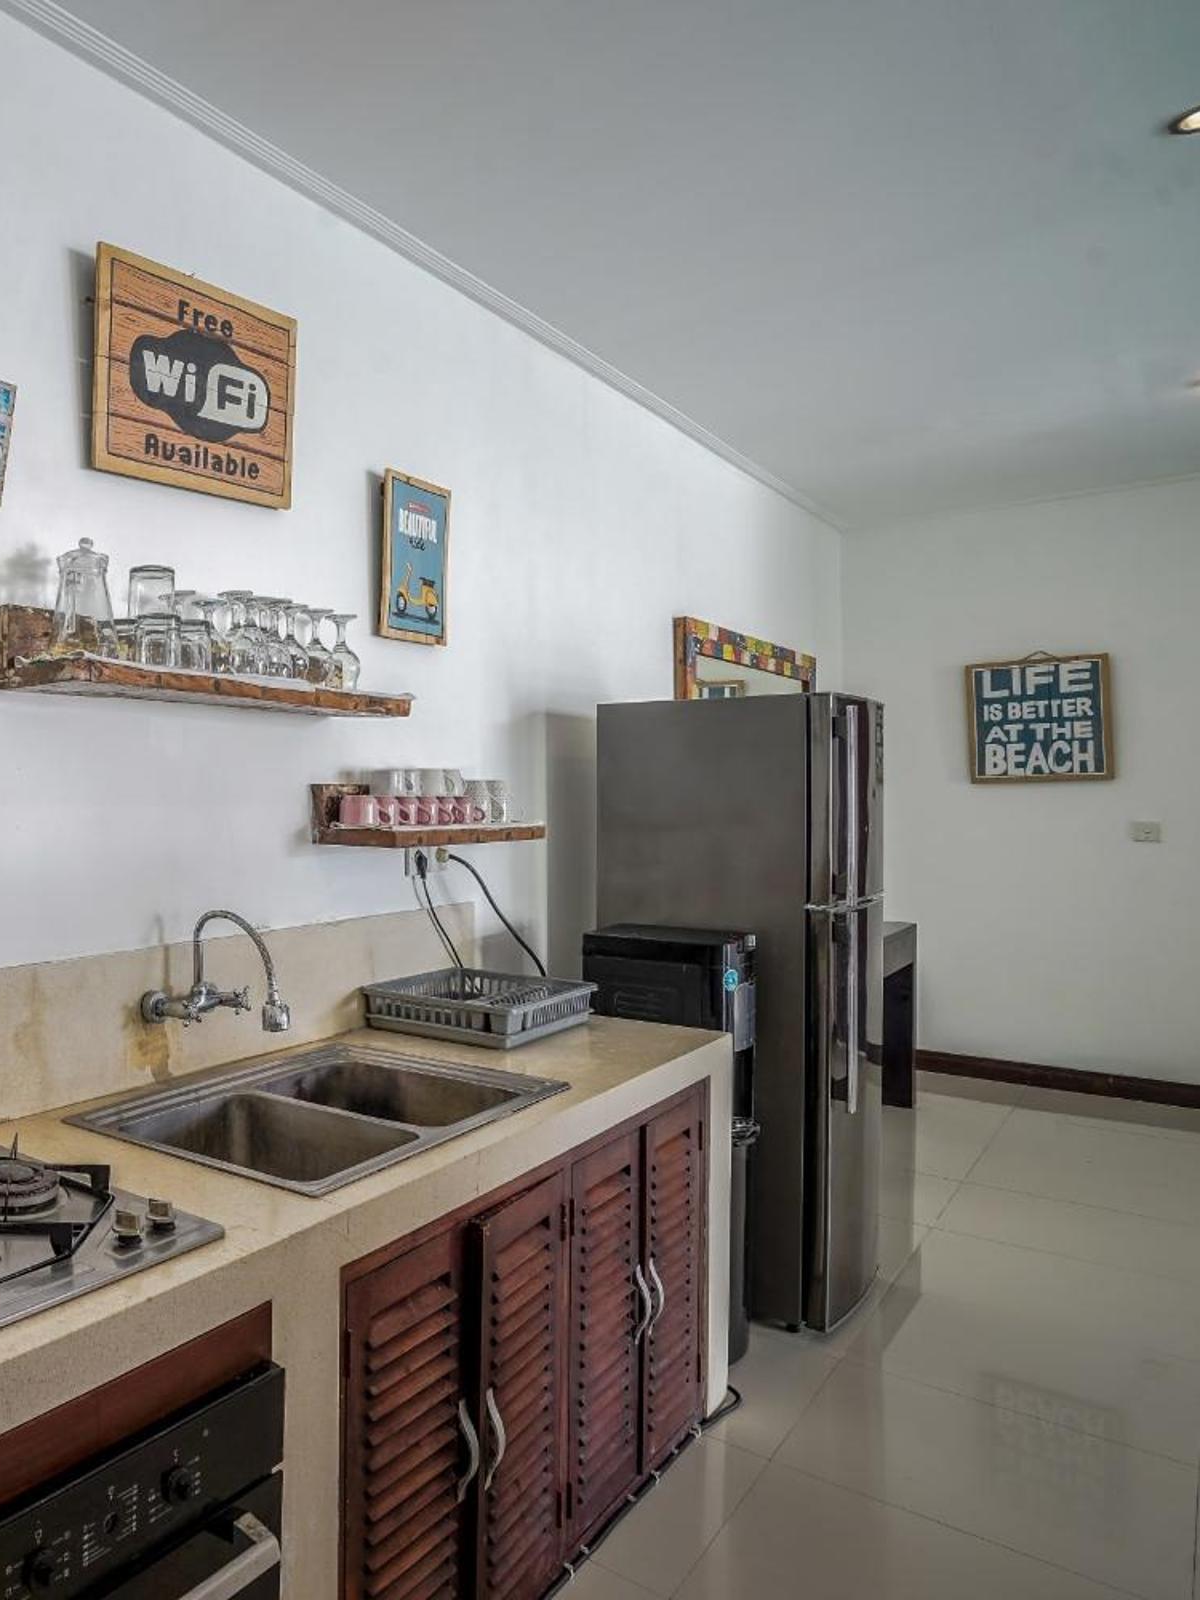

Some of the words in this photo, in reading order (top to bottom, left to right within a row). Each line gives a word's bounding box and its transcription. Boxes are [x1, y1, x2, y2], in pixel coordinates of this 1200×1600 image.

[178, 299, 233, 337] Free
[982, 661, 1094, 699] LIFE
[983, 703, 1003, 722] IS
[1007, 697, 1094, 720] BETTER
[984, 723, 1025, 743] AT
[1029, 720, 1094, 741] THE
[984, 740, 1096, 776] BEACH
